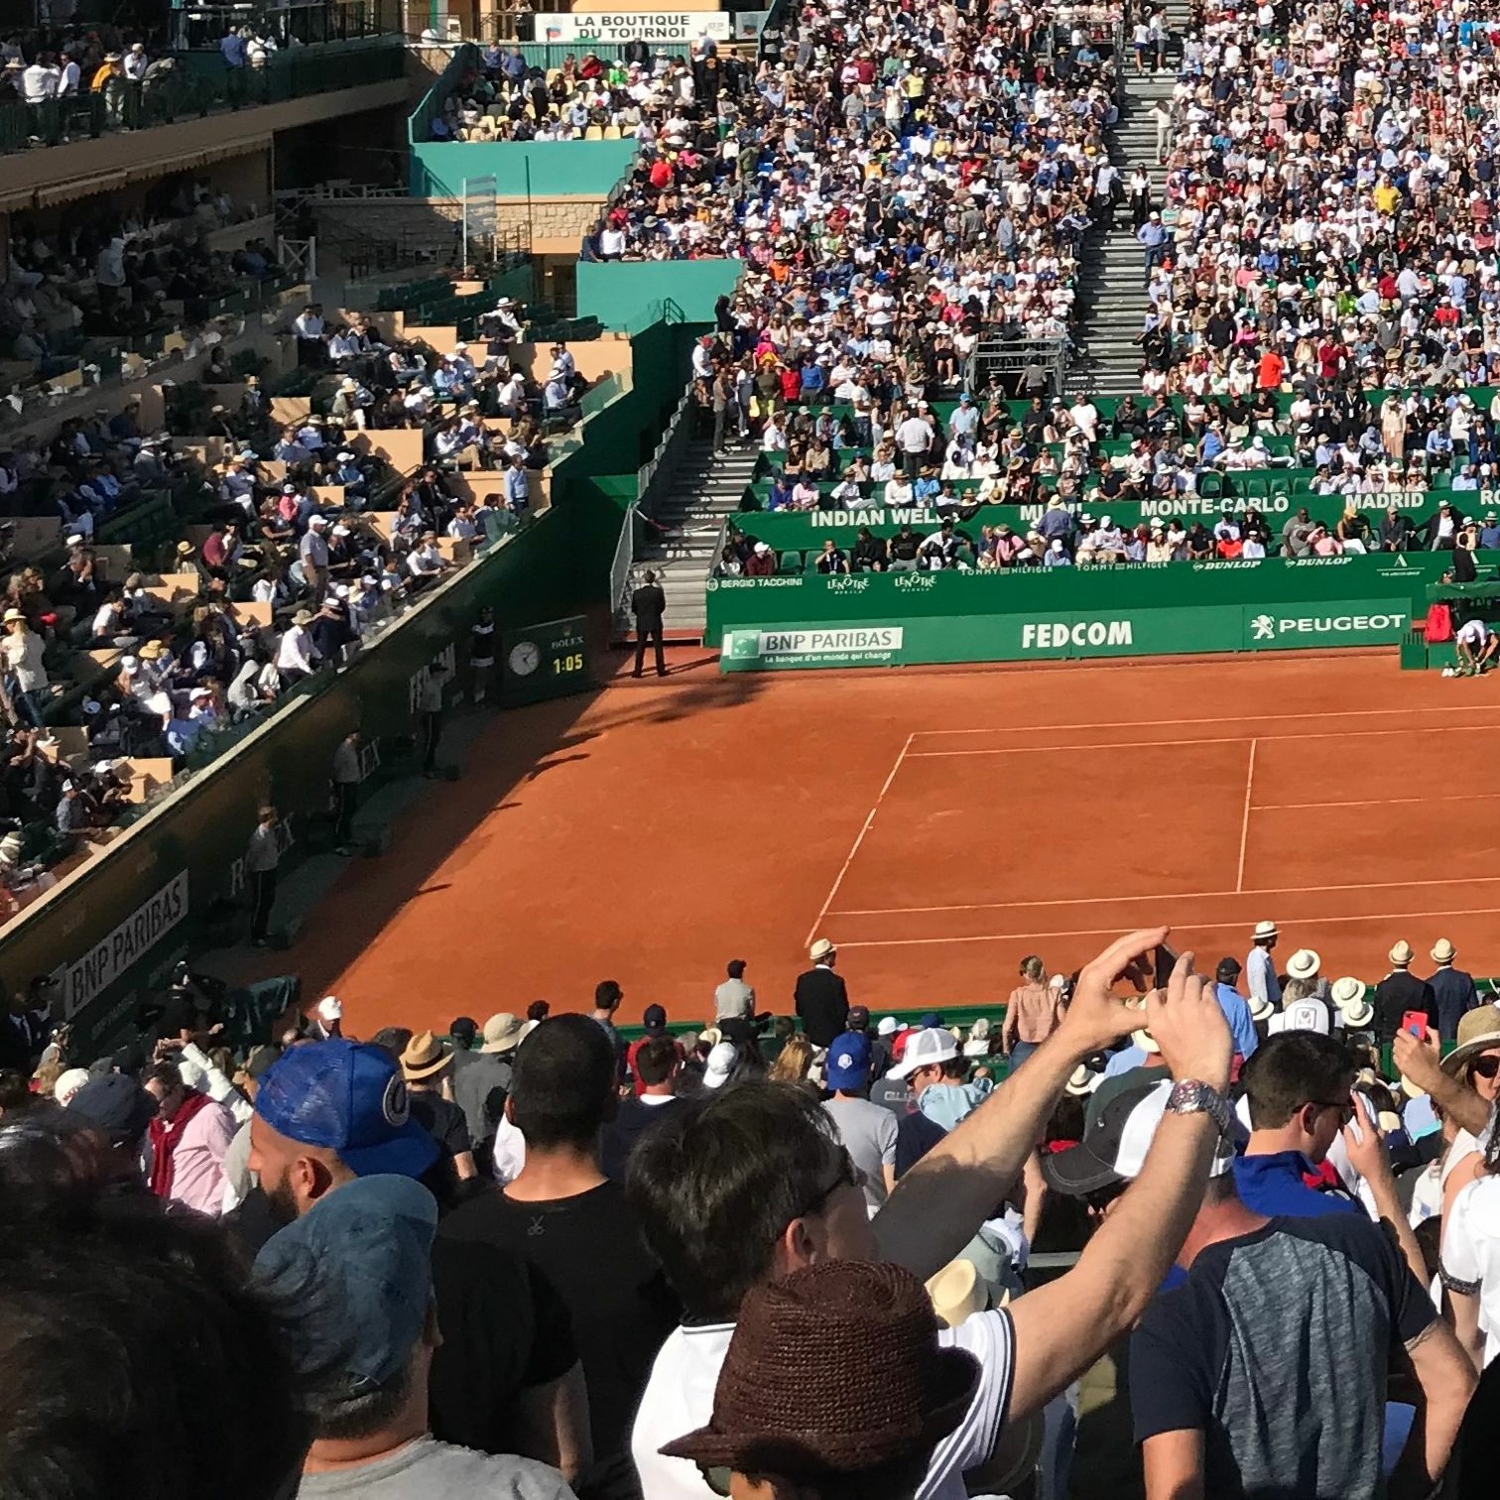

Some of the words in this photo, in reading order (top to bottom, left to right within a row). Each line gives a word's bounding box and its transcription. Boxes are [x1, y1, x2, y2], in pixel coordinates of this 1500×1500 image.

[574, 16, 595, 26] LA
[601, 15, 690, 26] BOUTIQUE
[579, 28, 602, 38] DU
[610, 27, 685, 38] TOURNOI
[1141, 496, 1289, 517] MONTE-CARLO
[1345, 492, 1425, 510] MADRID
[811, 510, 886, 528] INDIAN
[1203, 561, 1262, 571] DUNLOP
[1295, 557, 1353, 567] DUNLOP
[720, 579, 755, 589] SERGIO
[757, 577, 803, 587] TACCHINI
[1279, 614, 1407, 633] PEUGEOT
[551, 636, 585, 649] ROLEX
[766, 635, 805, 651] BNP
[811, 631, 892, 649] PARIBAS
[1022, 621, 1133, 649] FEDCOM
[552, 653, 584, 675] 1:05
[71, 953, 110, 1009] BNP
[113, 880, 182, 972] PARIBAS
